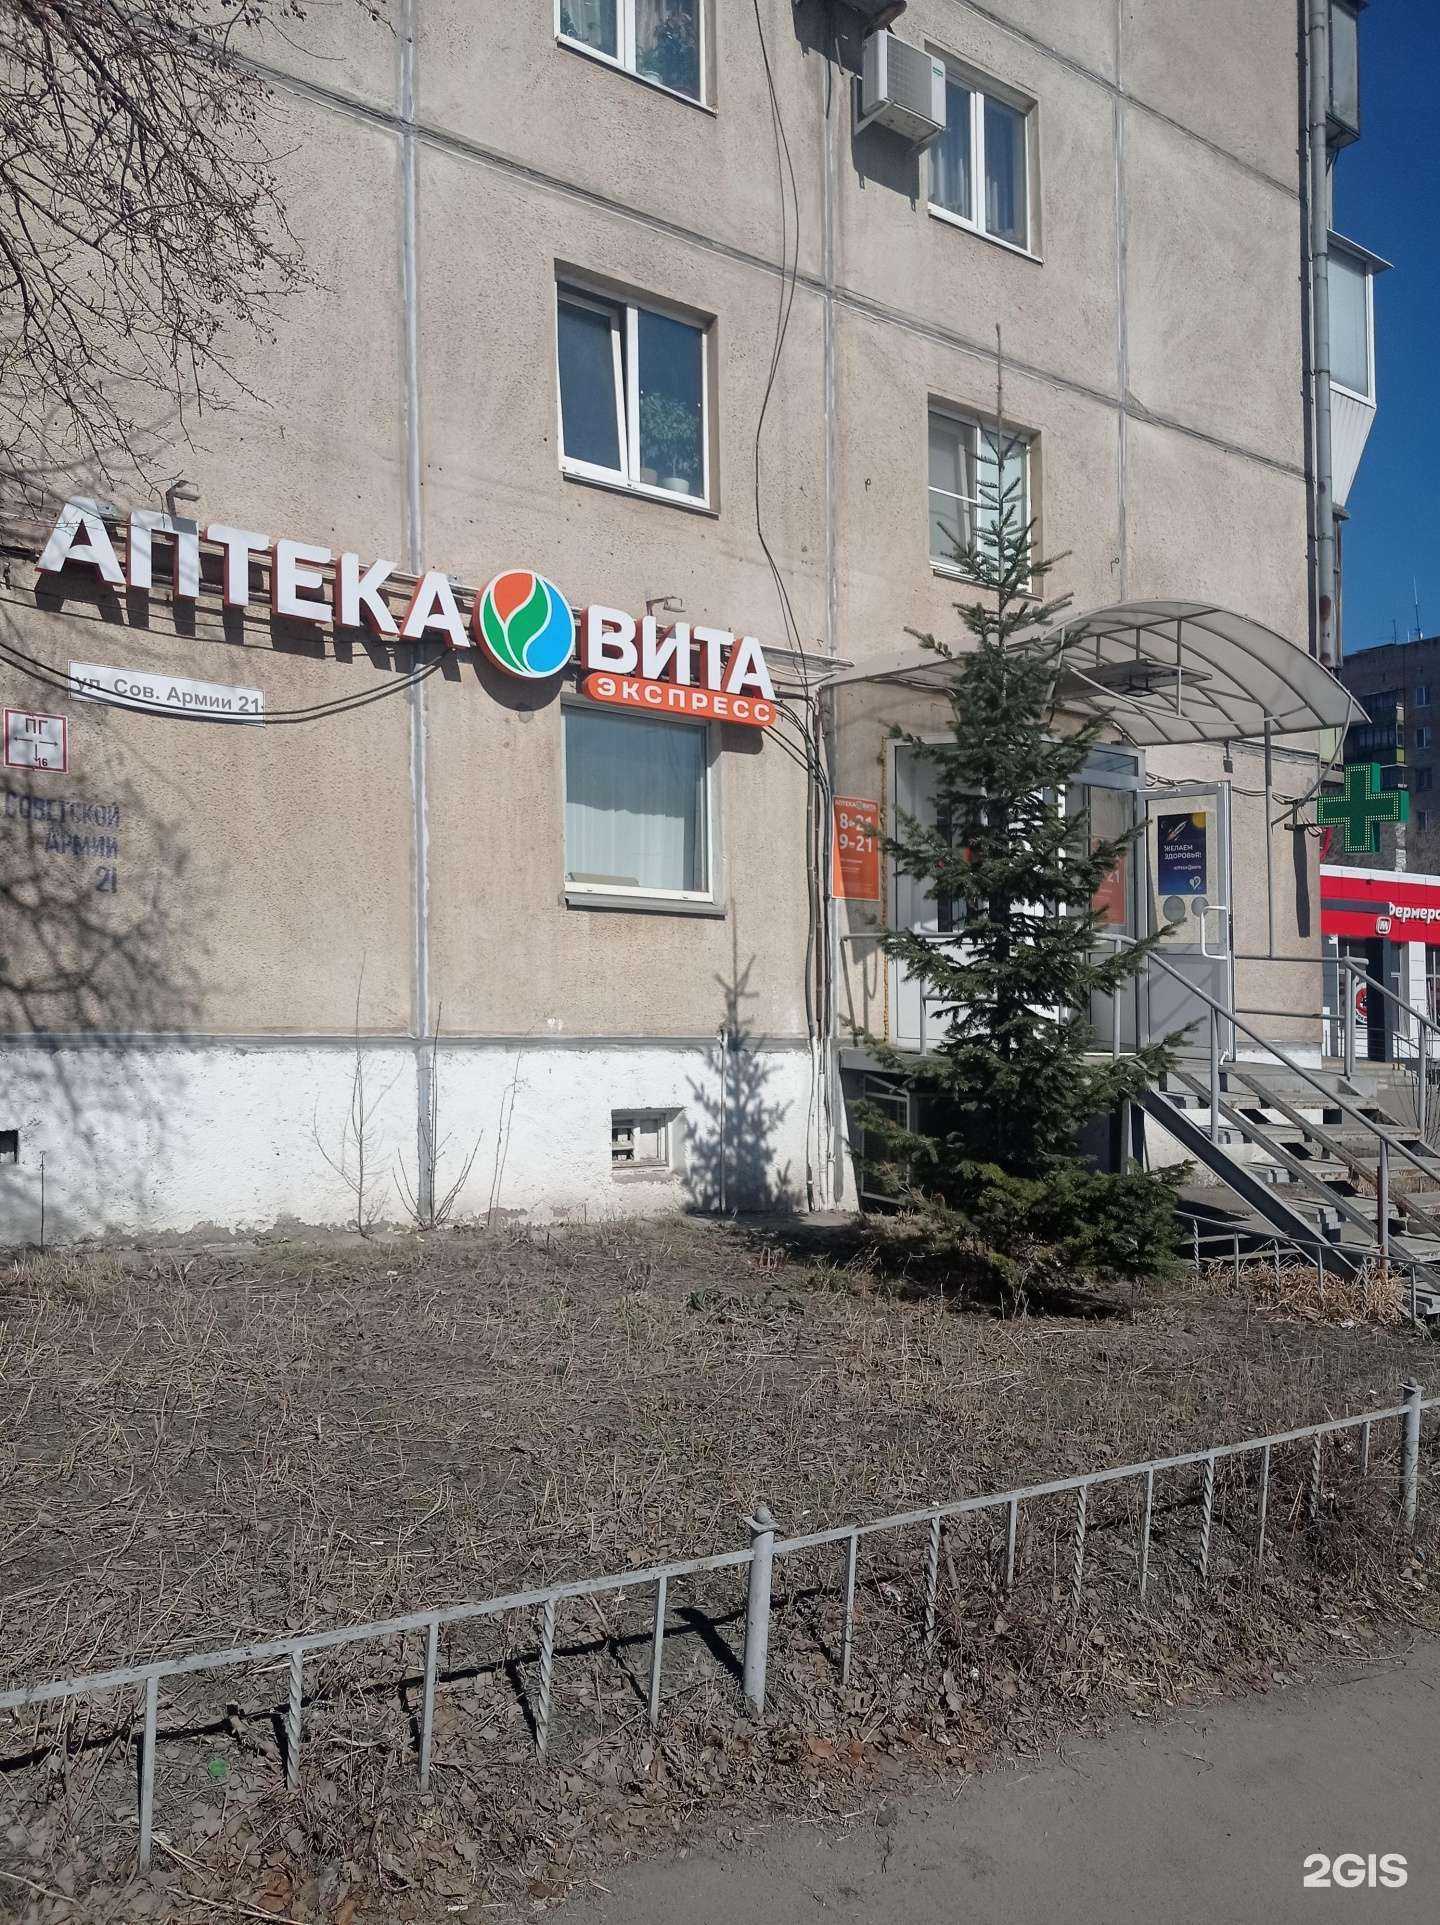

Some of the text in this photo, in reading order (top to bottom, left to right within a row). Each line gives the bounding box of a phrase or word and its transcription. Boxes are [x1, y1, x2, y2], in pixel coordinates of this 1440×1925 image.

[36, 496, 778, 702] АПТЕКА ВИТА
[75, 676, 259, 713] ул Сов. Армии 21
[597, 676, 771, 722] ЭКСПРЕСС
[25, 718, 48, 734] ПГ
[38, 758, 48, 767] 16
[839, 833, 872, 853] 9-21
